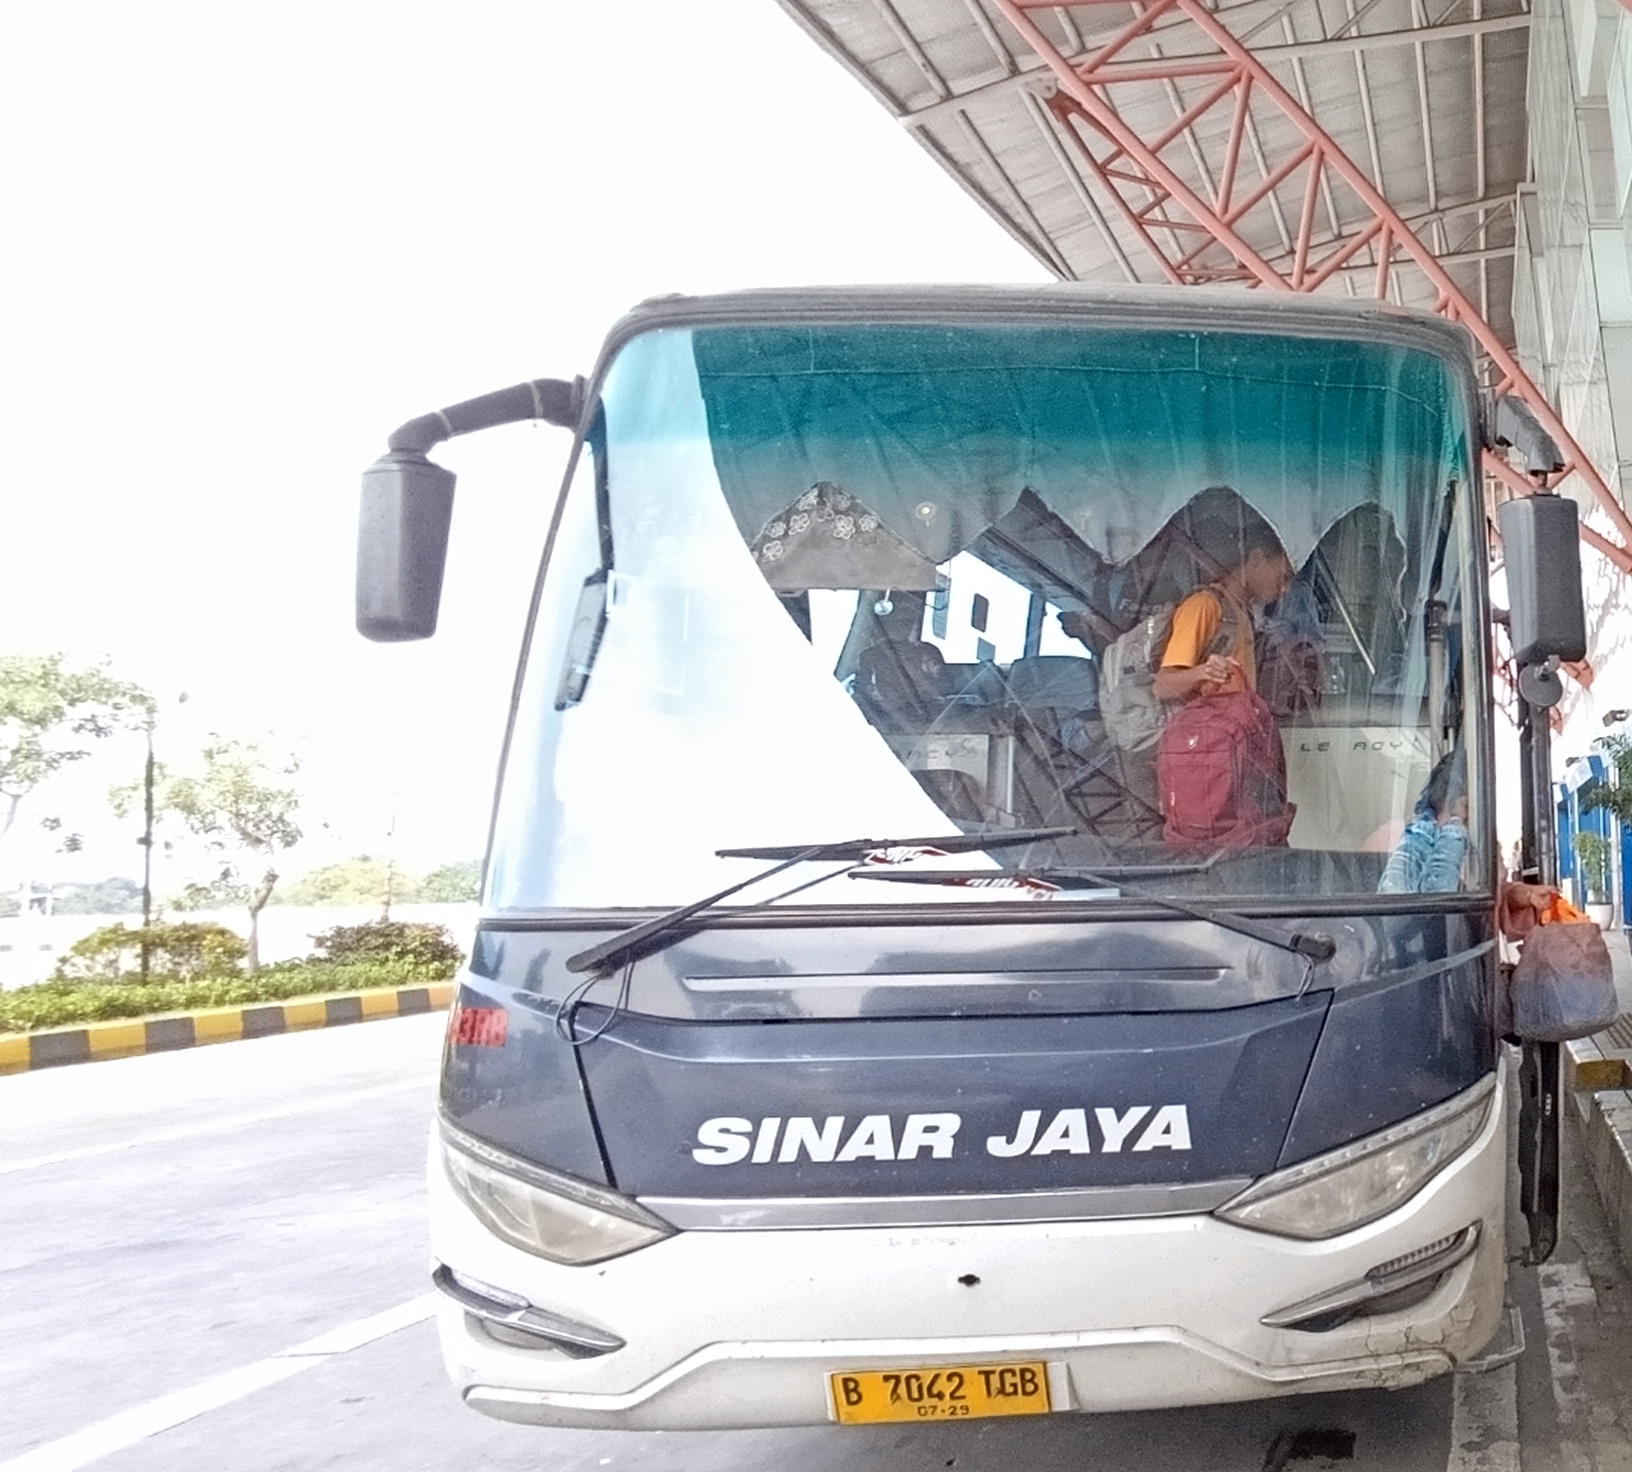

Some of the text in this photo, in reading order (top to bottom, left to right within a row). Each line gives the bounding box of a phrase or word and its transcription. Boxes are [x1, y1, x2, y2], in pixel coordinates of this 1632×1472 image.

[692, 1104, 1193, 1165] SINAR JAYA
[842, 1368, 1040, 1406] B 7042 TGB
